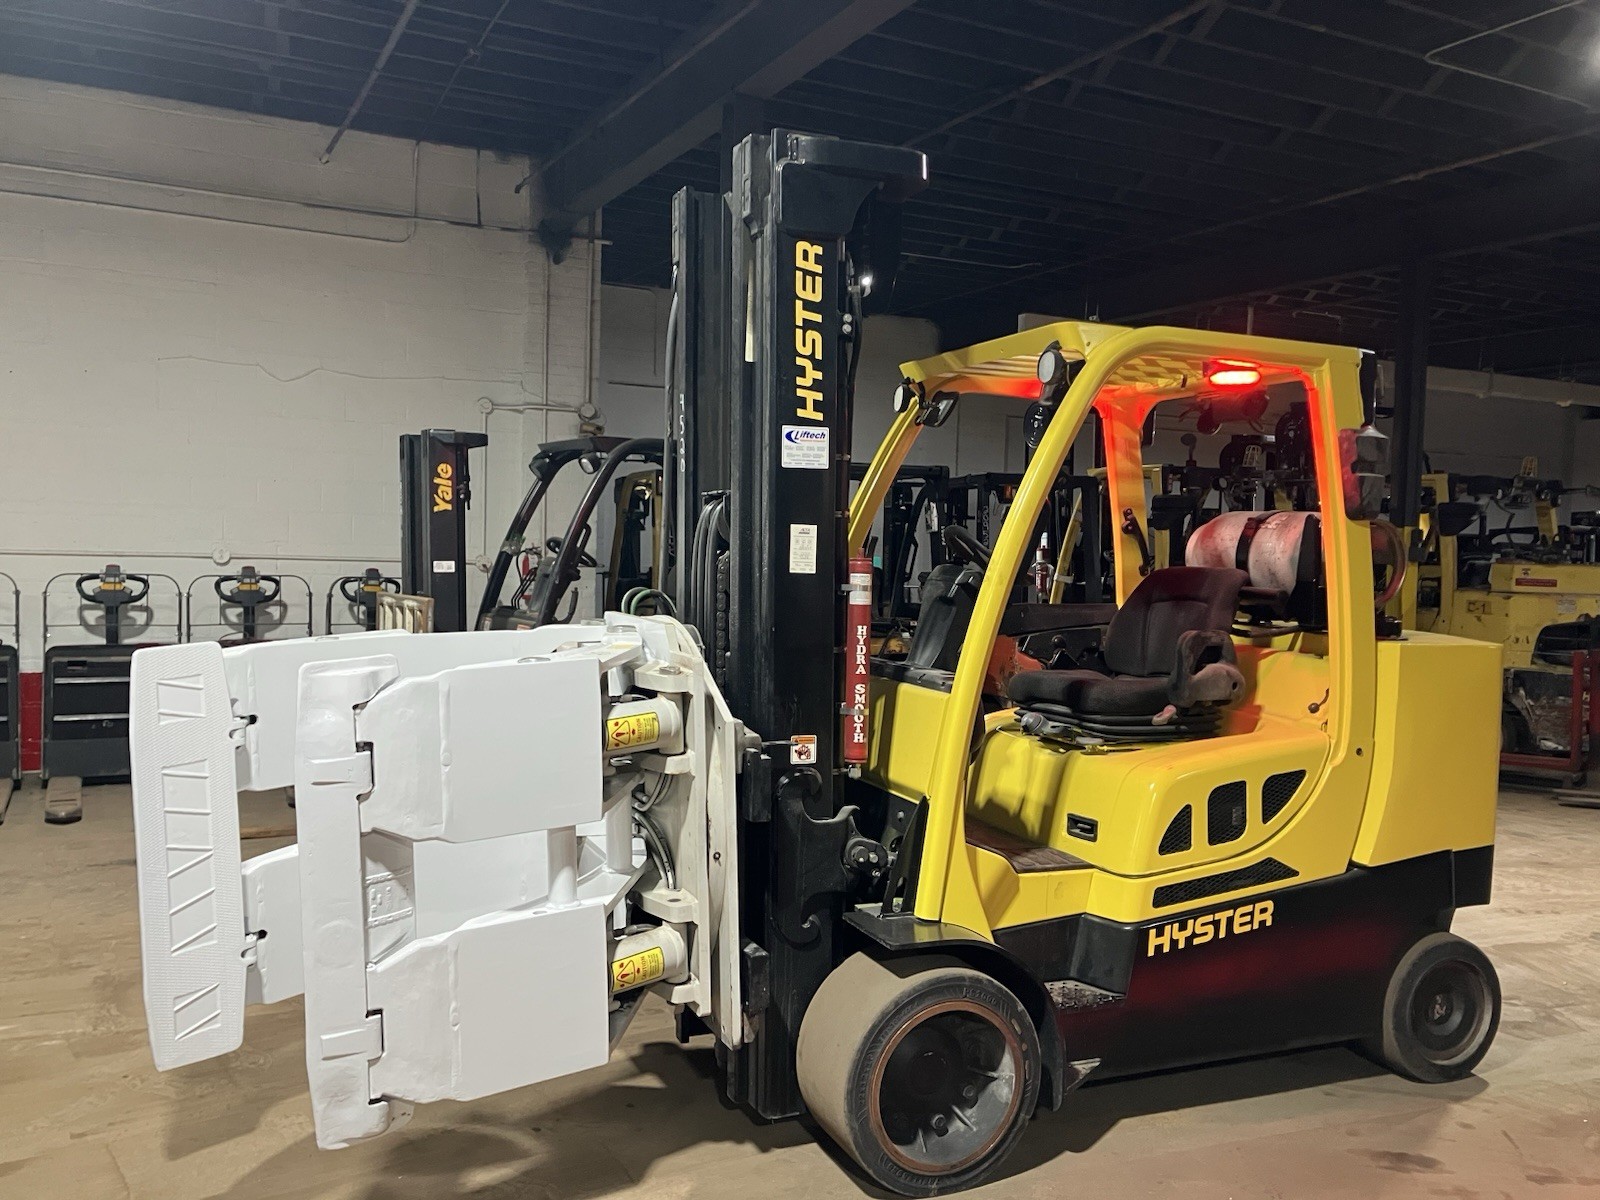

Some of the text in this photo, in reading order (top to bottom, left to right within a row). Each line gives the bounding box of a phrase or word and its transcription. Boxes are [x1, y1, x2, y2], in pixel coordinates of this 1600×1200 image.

[795, 240, 823, 421] HYSTER
[794, 430, 826, 439] Liftech
[433, 463, 452, 512] Yale
[853, 625, 867, 744] HYDRA SMOOTH
[1147, 900, 1275, 957] HYSTER
